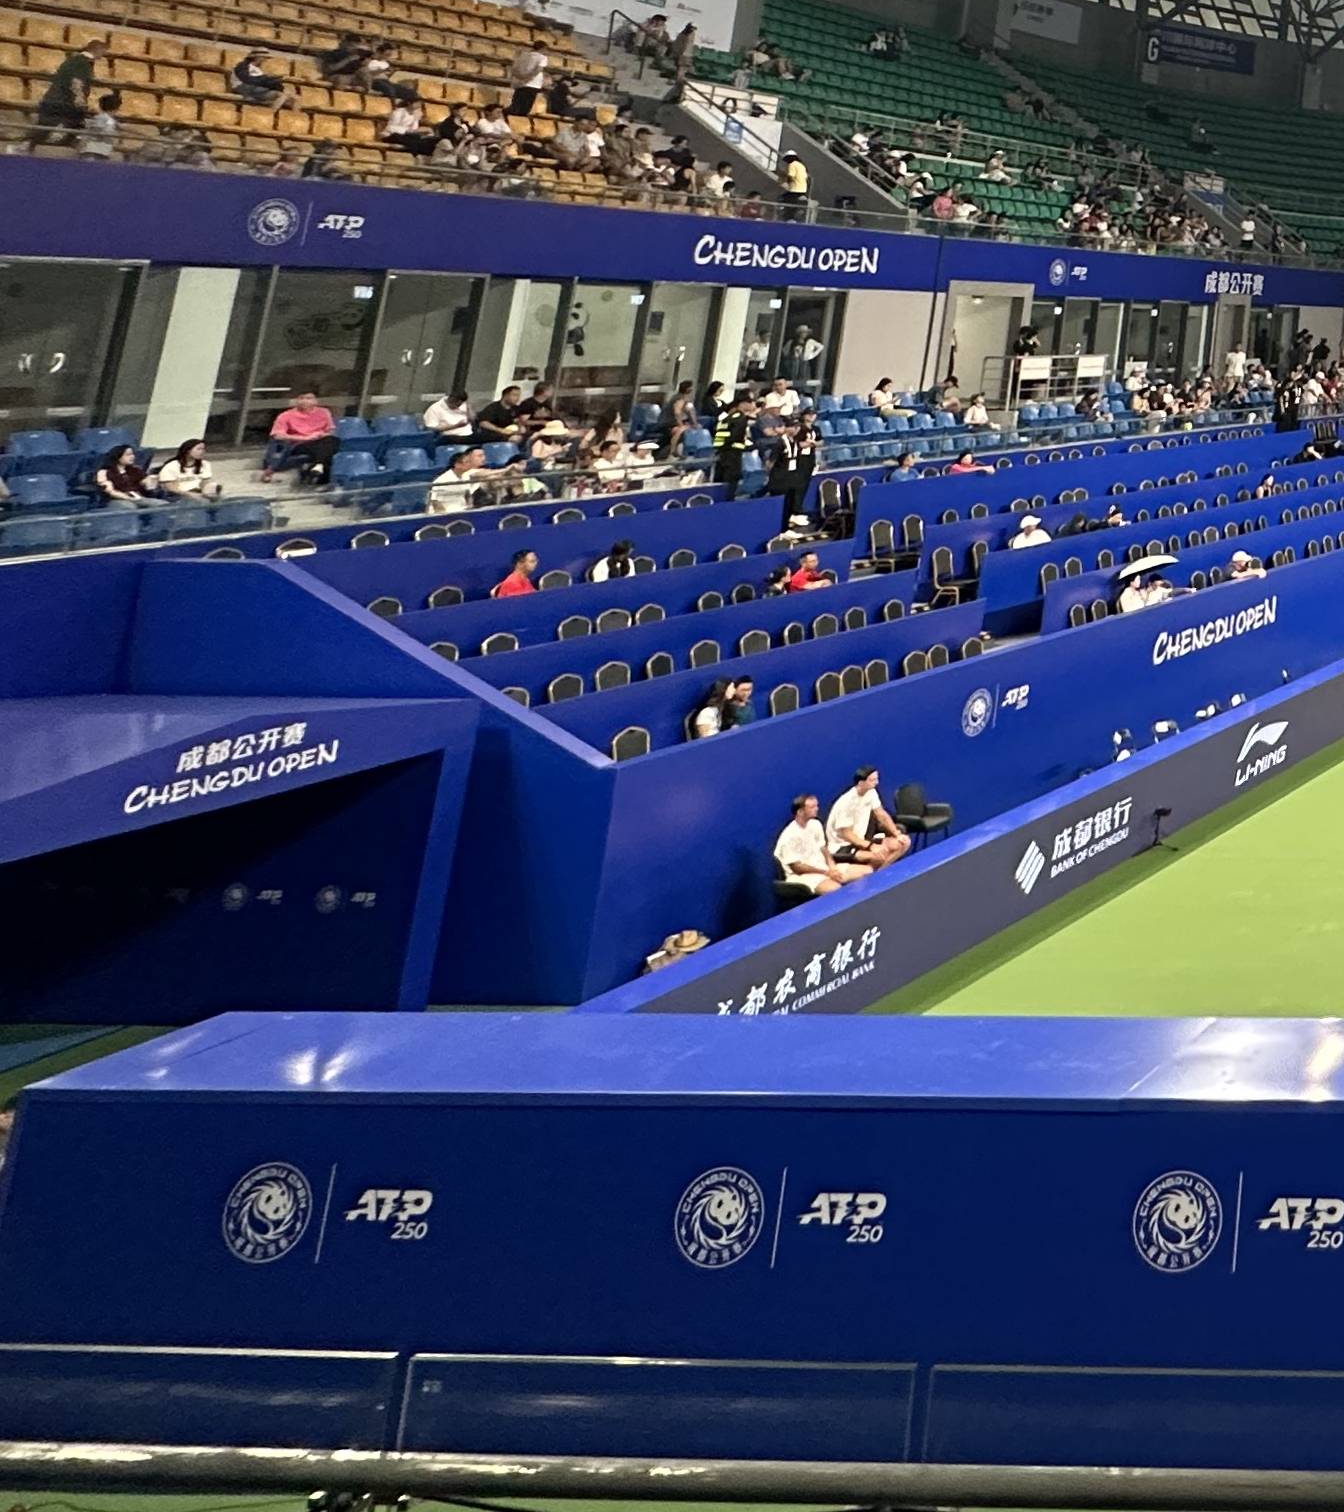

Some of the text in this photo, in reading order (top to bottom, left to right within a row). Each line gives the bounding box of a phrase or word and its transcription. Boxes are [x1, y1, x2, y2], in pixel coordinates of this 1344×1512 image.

[1148, 36, 1159, 62] G
[317, 214, 366, 230] ATP
[694, 234, 880, 274] CHENGDU OPEN
[1204, 270, 1265, 296] 成都公开赛
[1152, 595, 1278, 666] CHENGDU OPEN
[1001, 684, 1030, 708] ATP
[175, 721, 308, 774] 成都公开赛
[124, 739, 340, 814] CHENGDU OPEN
[1234, 743, 1288, 787] LI-NING
[1051, 795, 1133, 861] 成都银行
[1050, 827, 1129, 878] BANK OF CHENGDU
[851, 959, 876, 981] BANK
[343, 1189, 434, 1222] ATP
[797, 1192, 888, 1225] ATP
[1139, 1176, 1193, 1218] CHENGDU
[390, 1221, 428, 1239] 250
[846, 1225, 884, 1243] 250
[1306, 1230, 1344, 1249] 250
